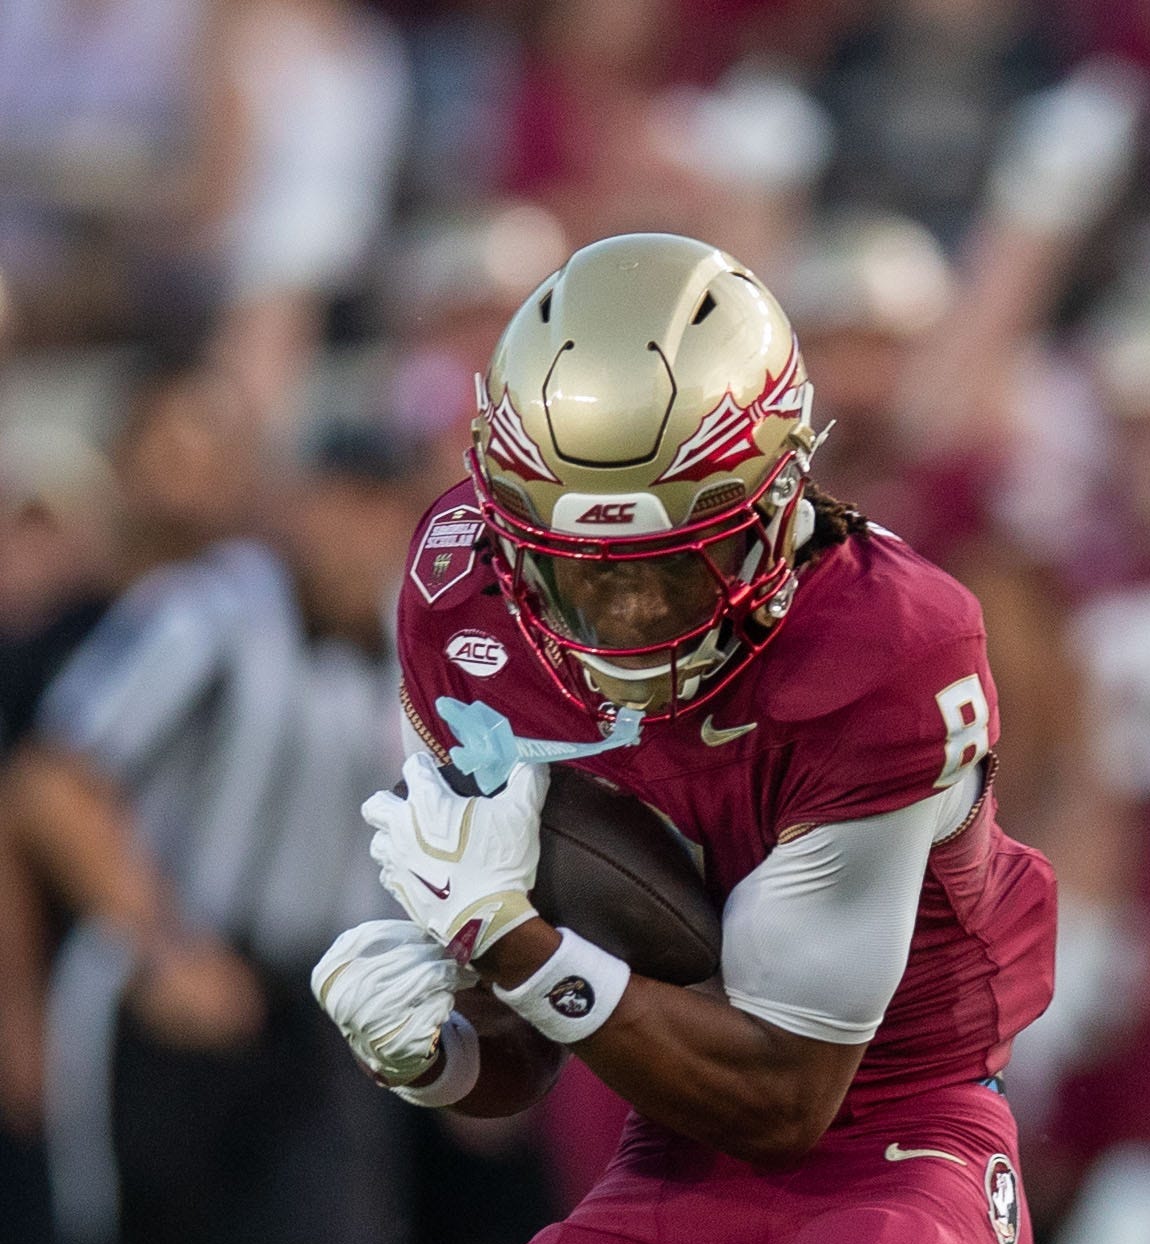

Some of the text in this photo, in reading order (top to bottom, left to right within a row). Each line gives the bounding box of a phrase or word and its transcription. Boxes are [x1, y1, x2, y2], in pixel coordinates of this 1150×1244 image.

[575, 502, 638, 524] ACC
[455, 642, 500, 661] ACC
[932, 673, 990, 789] 8
